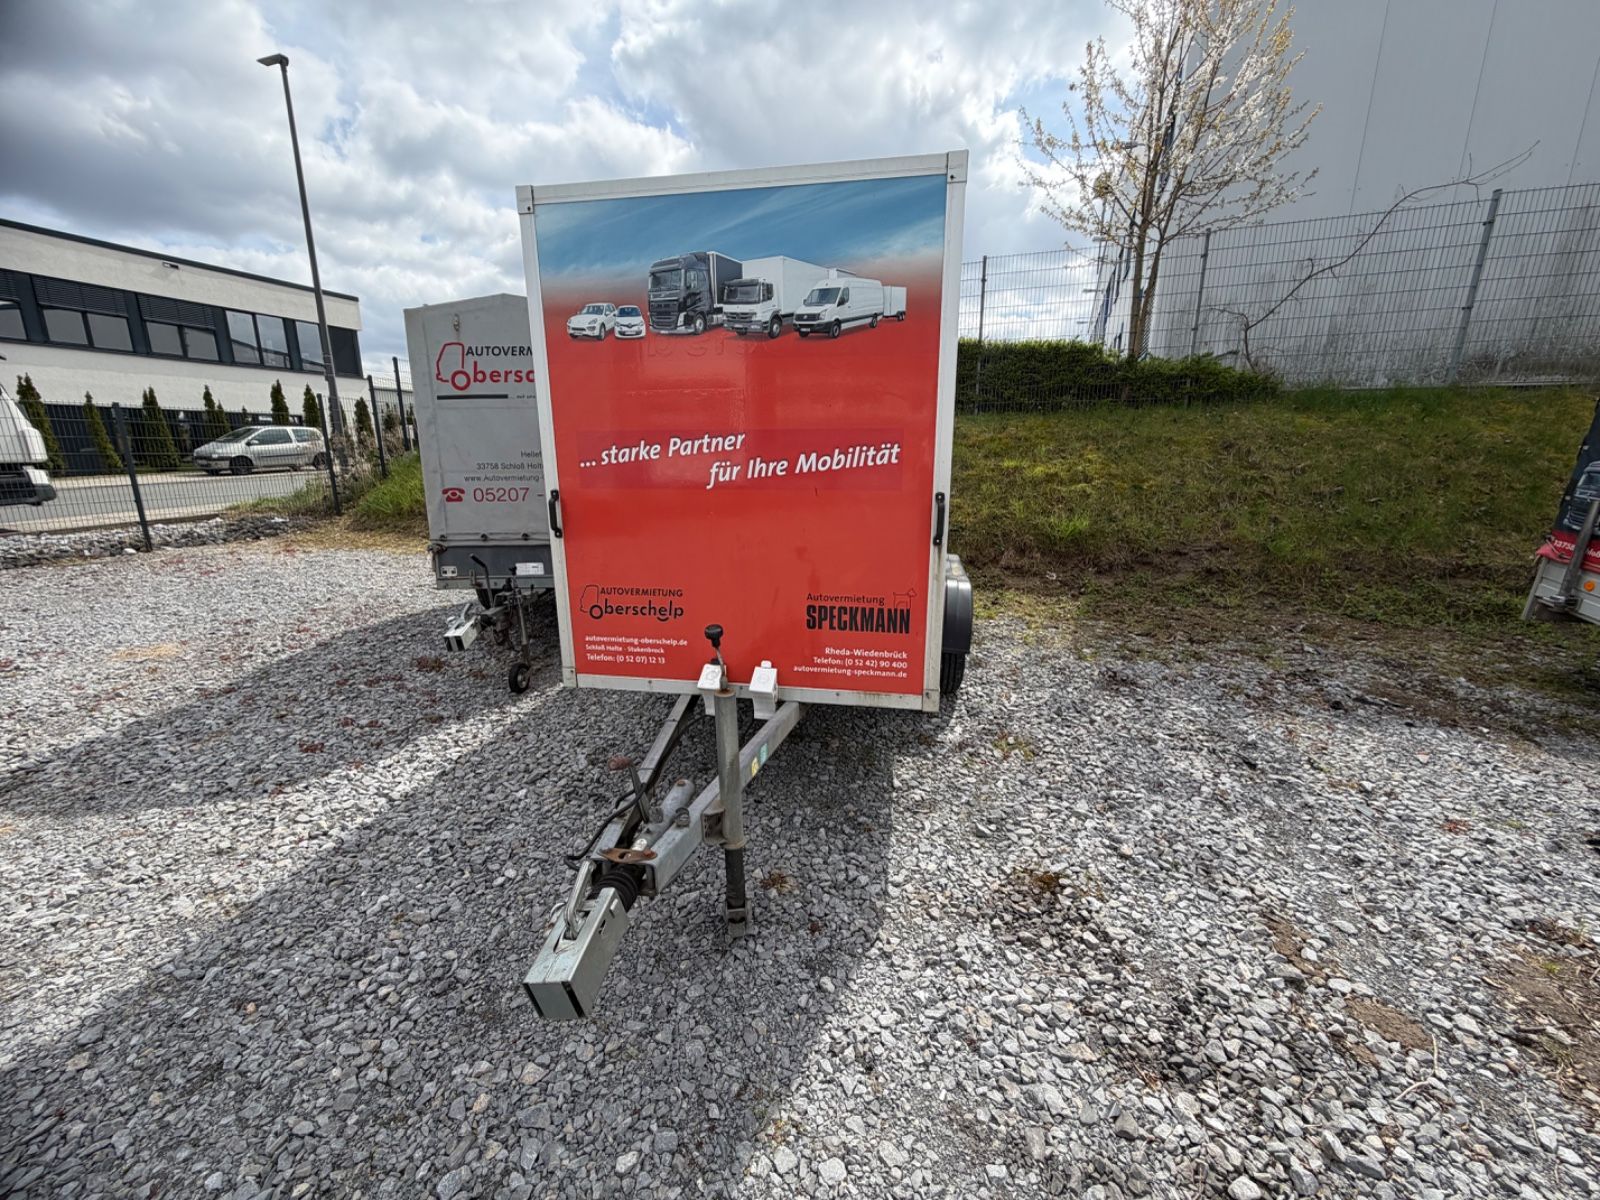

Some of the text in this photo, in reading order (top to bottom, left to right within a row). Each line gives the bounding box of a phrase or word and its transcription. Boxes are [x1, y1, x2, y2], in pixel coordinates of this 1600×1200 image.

[601, 440, 661, 466] starke
[668, 432, 746, 458] Partner
[476, 462, 499, 470] 33758
[706, 443, 901, 489] für Ihre Mobilität
[473, 487, 530, 502] 05207
[600, 587, 684, 598] AUTOVERMIETUNG
[806, 593, 885, 606] Autovermietung
[806, 605, 911, 634] SPECKMANN
[585, 635, 688, 647] autovermietung-oberschelp.de
[586, 653, 615, 662] Telefon:
[616, 654, 625, 664] (0
[625, 655, 634, 663] 52
[635, 656, 648, 665] 07)
[825, 647, 908, 660] Rheda-Wiedenbrück
[813, 657, 908, 670] Telefon: (0 52 42) 90 400
[793, 664, 908, 679] autovermietung-speckmann.de
